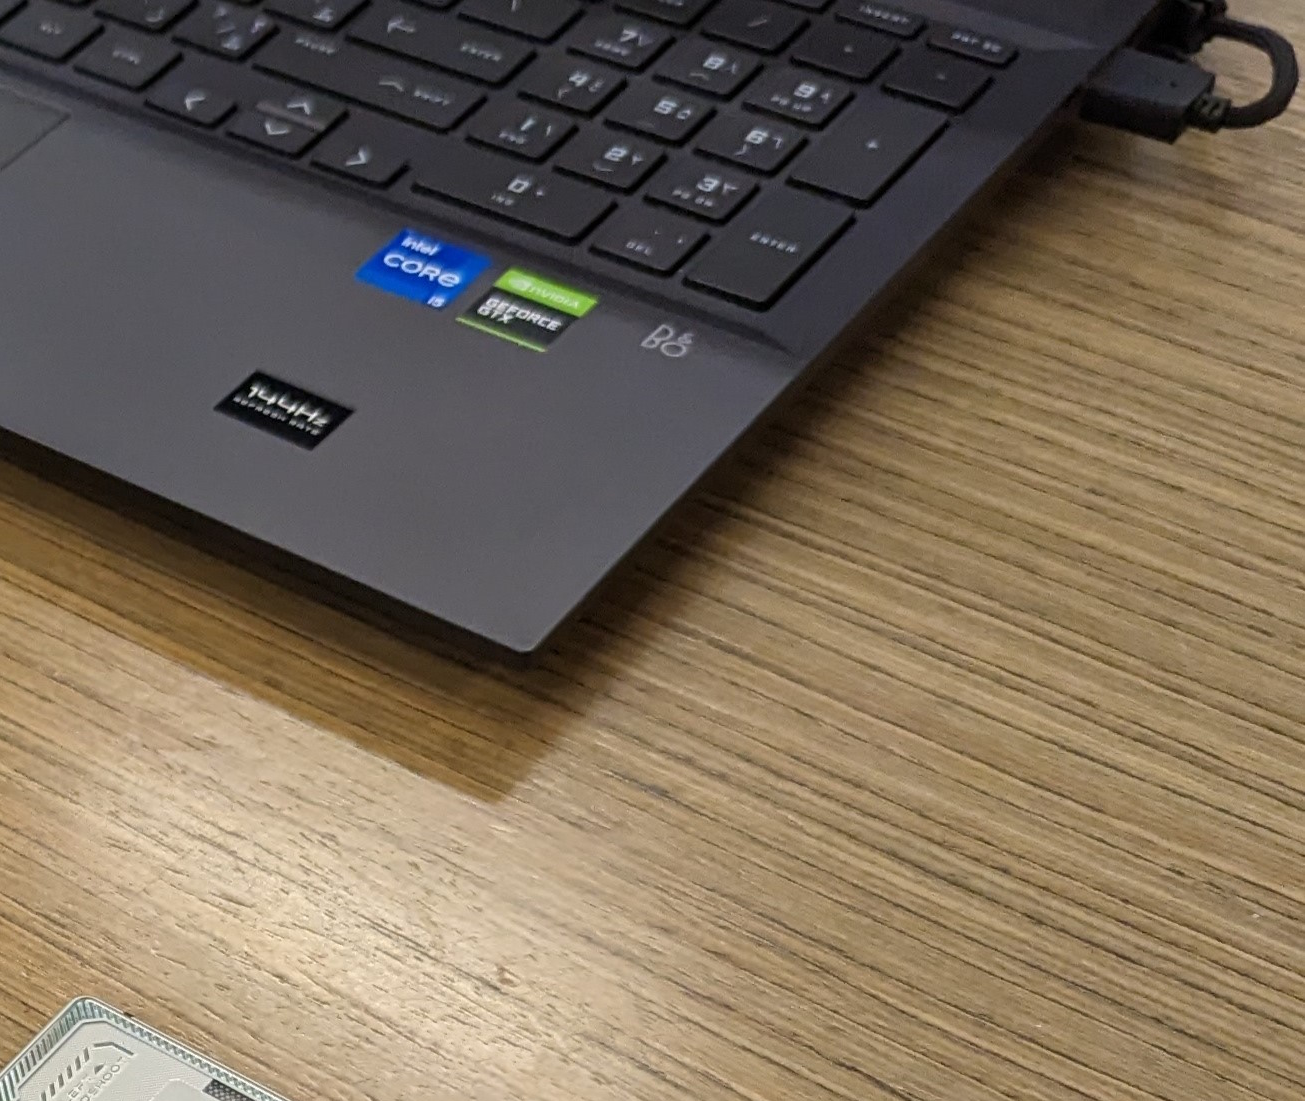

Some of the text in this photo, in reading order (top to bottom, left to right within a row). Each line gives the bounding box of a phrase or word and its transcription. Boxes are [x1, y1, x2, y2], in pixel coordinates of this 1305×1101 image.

[620, 29, 637, 42] 7
[703, 55, 725, 70] 8
[569, 71, 589, 87] 4
[794, 83, 816, 98] 9
[654, 97, 678, 114] 5
[745, 129, 768, 144] 6
[604, 147, 629, 161] 2
[507, 177, 530, 193] 0
[696, 176, 720, 192] 3
[478, 306, 515, 324] GTX
[485, 298, 562, 331] GEFORCE
